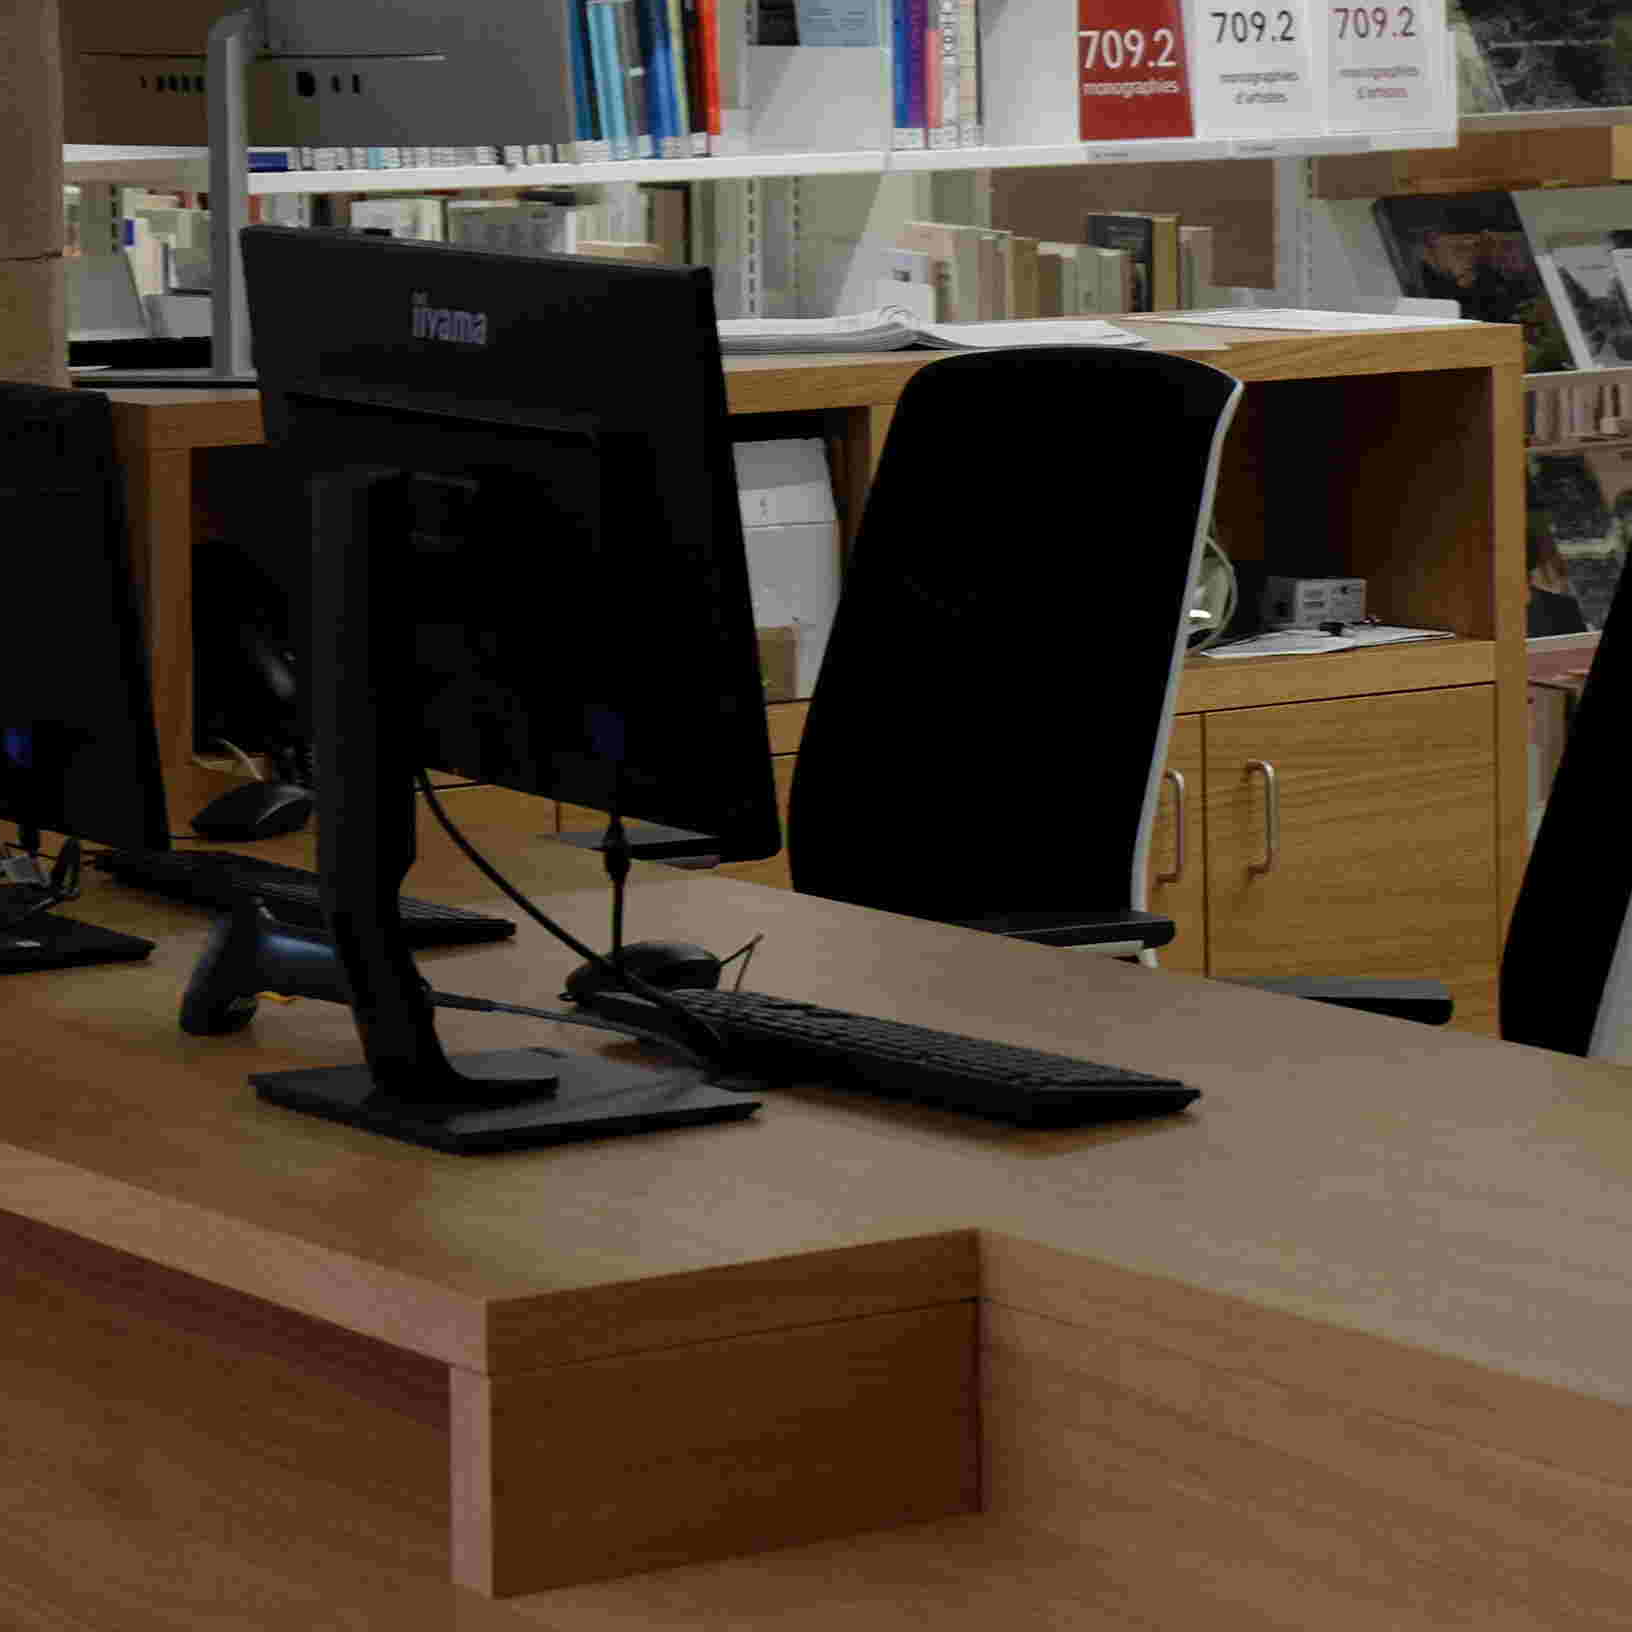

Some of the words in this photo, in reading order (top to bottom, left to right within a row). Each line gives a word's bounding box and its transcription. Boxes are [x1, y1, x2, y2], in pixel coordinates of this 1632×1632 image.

[1210, 10, 1295, 44] 709.2
[1331, 5, 1416, 40] 709.2
[1078, 28, 1177, 69] 709.2
[1082, 76, 1180, 99] monographies
[1219, 69, 1299, 87] monographies
[1339, 63, 1420, 82] monographies
[412, 291, 487, 347] iiyama
